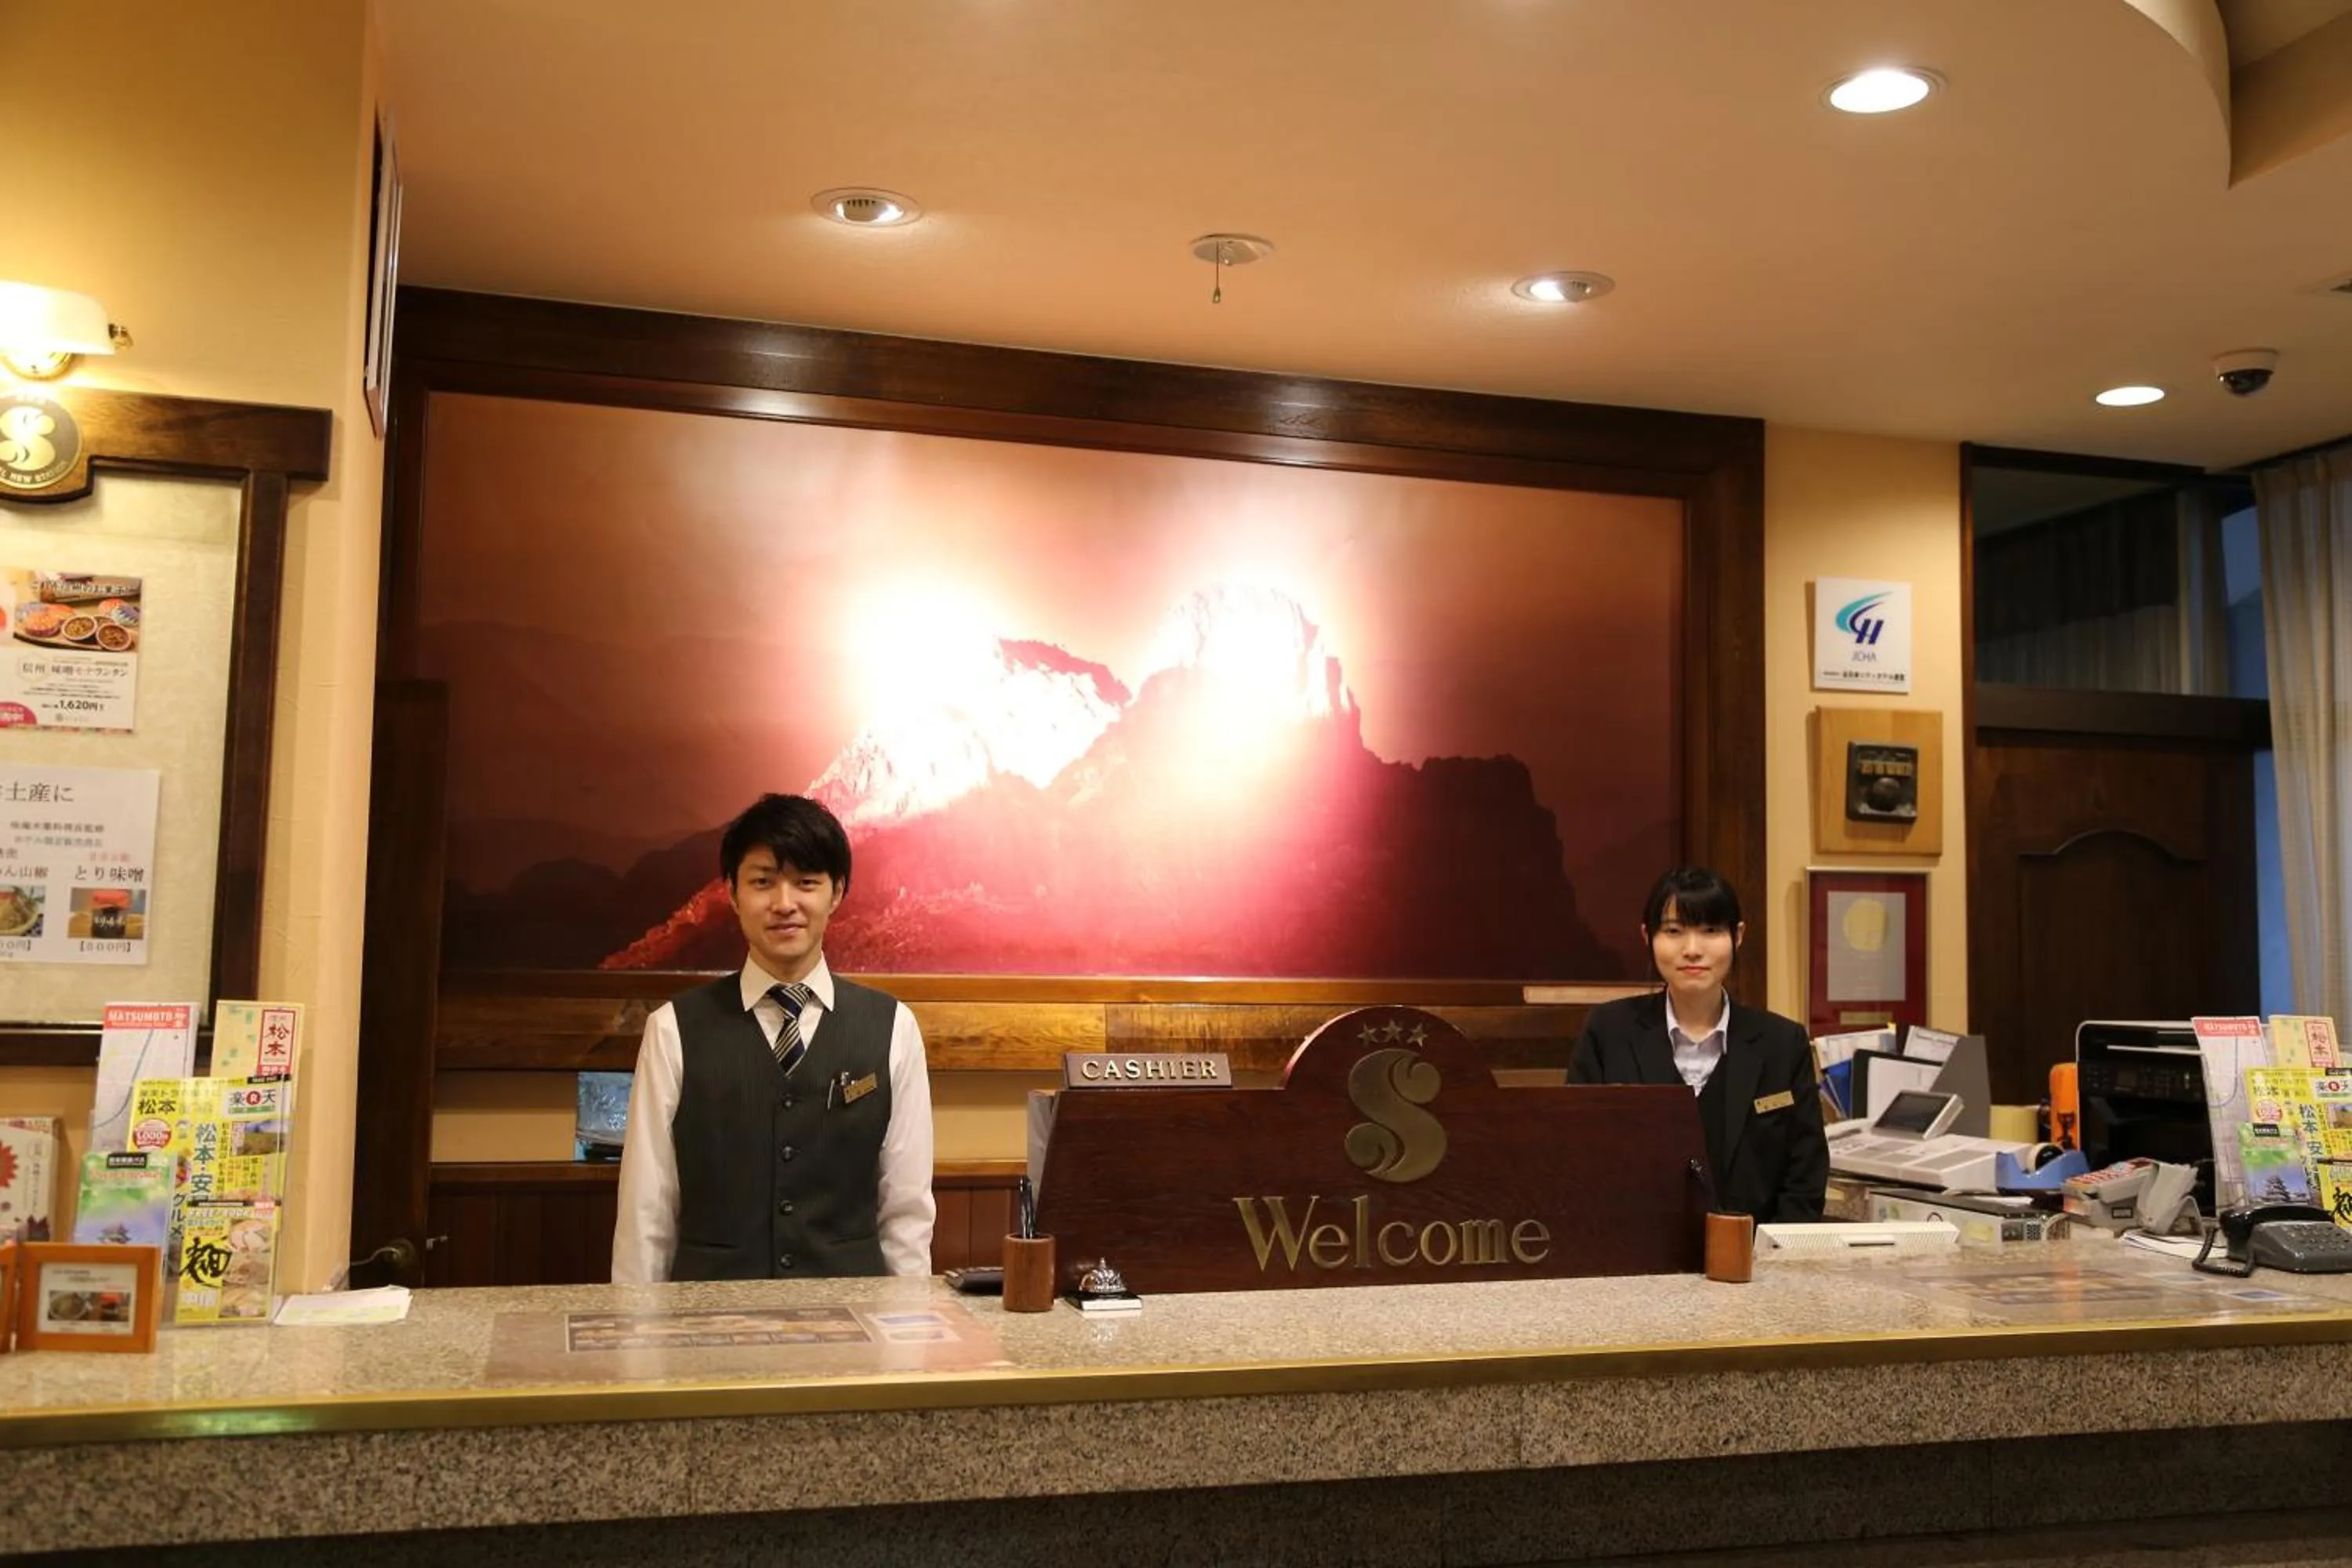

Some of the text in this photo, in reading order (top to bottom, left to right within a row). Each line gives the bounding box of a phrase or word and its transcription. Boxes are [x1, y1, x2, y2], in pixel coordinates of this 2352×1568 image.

[0, 782, 74, 804] 土産に
[75, 865, 145, 883] とり味噌
[107, 1010, 172, 1022] MATSUMOTO
[263, 1023, 290, 1057] 松本
[1081, 1059, 1218, 1080] CASHIER
[1232, 1195, 1551, 1272] Welcome
